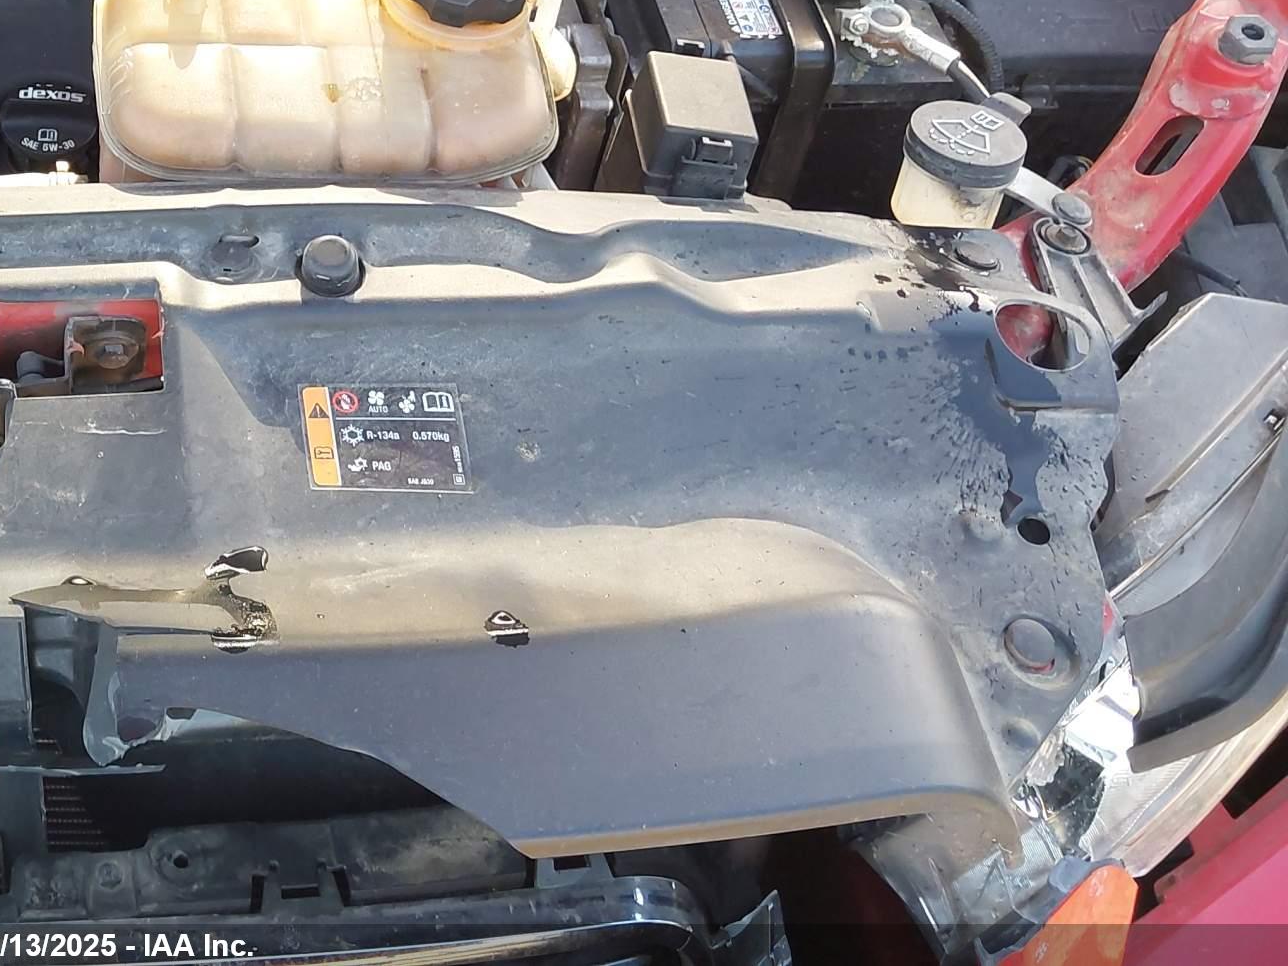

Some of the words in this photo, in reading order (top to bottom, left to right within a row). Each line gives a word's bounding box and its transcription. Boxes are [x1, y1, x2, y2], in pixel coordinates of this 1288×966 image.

[18, 86, 87, 103] dexos
[21, 137, 39, 150] SAE
[42, 139, 75, 152] 5W-30
[368, 405, 389, 413] AUTO
[366, 430, 400, 440] R-134a
[372, 461, 392, 471] PAG
